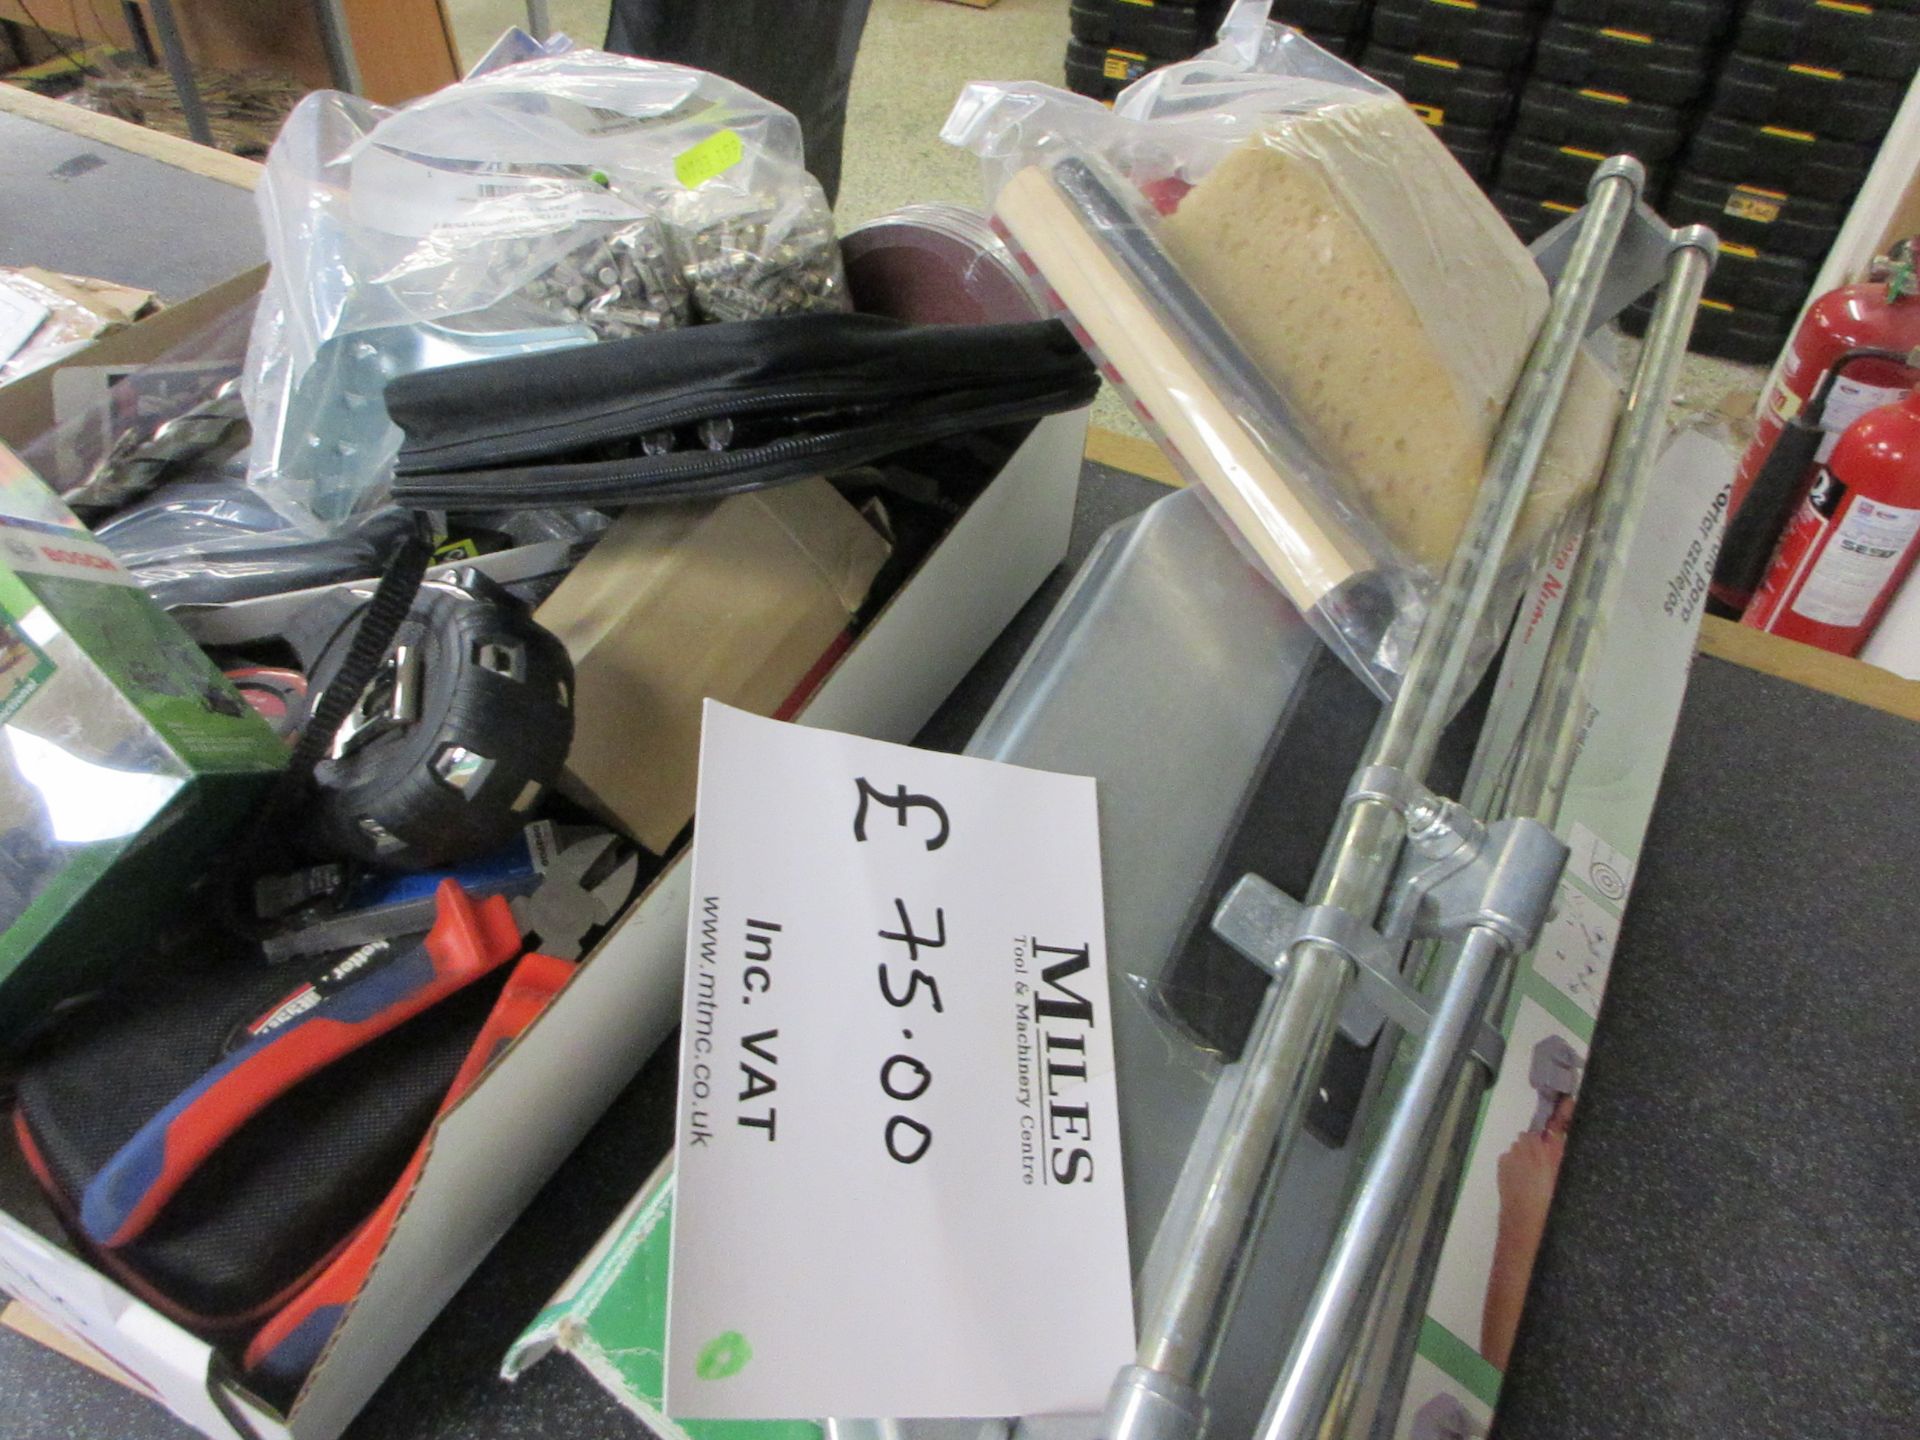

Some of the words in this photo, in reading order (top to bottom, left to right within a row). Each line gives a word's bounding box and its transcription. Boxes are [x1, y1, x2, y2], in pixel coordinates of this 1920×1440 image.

[40, 546, 119, 571] BOSCH
[853, 777, 950, 851] £
[743, 918, 783, 1005] Inc.
[1013, 936, 1028, 976] Tool
[1014, 980, 1028, 996] &
[689, 896, 720, 1147] www.mtmc.co.uk
[878, 898, 946, 1165] 75.00
[1014, 1004, 1032, 1109] Machinery
[1031, 936, 1094, 1185] MILES
[737, 1029, 778, 1142] VAT
[1020, 1111, 1036, 1186] Centre
